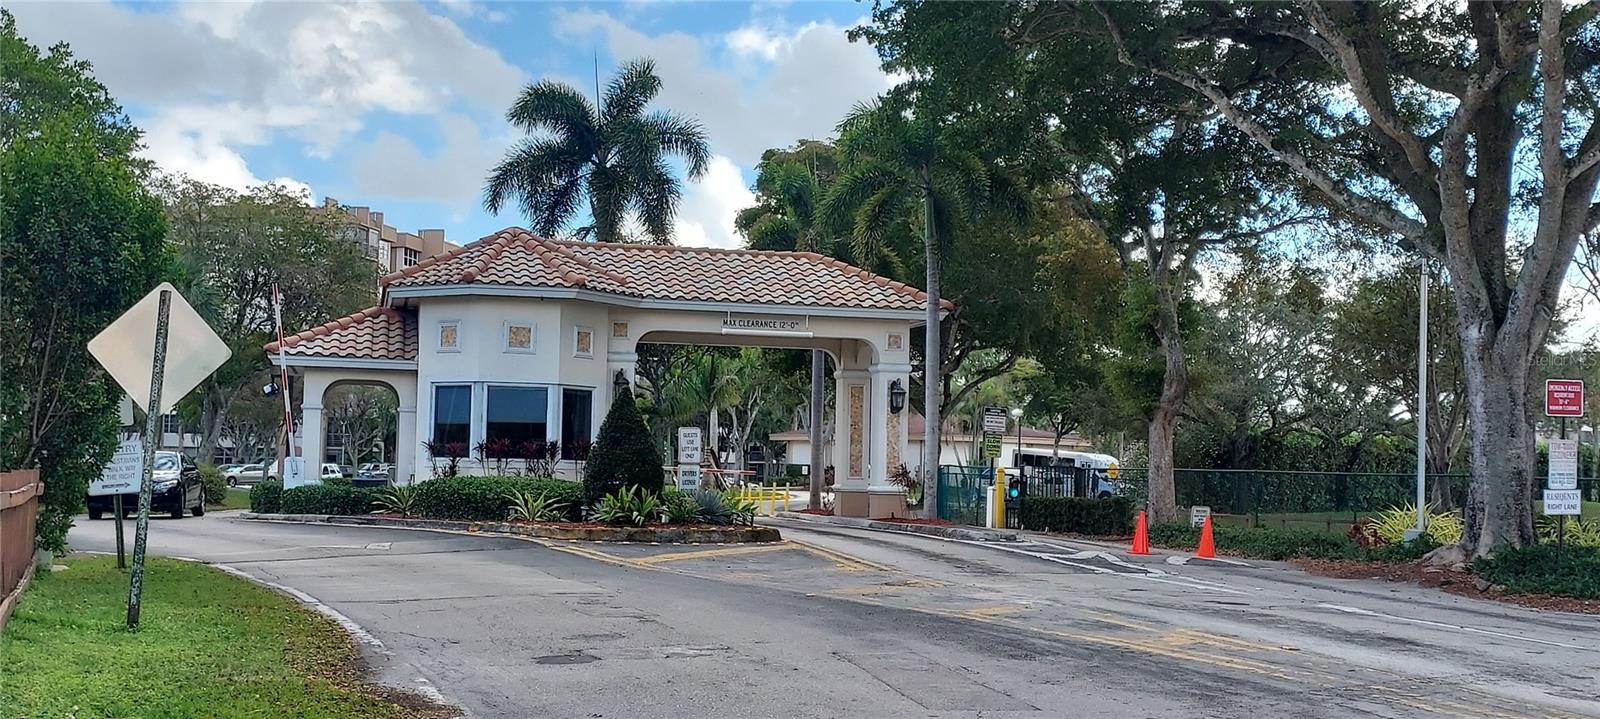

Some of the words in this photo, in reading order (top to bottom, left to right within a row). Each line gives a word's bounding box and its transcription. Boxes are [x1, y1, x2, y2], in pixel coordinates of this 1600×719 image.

[722, 319, 737, 327] MAX
[738, 319, 776, 328] CLEARANCE
[1546, 493, 1579, 501] RESIDENTS
